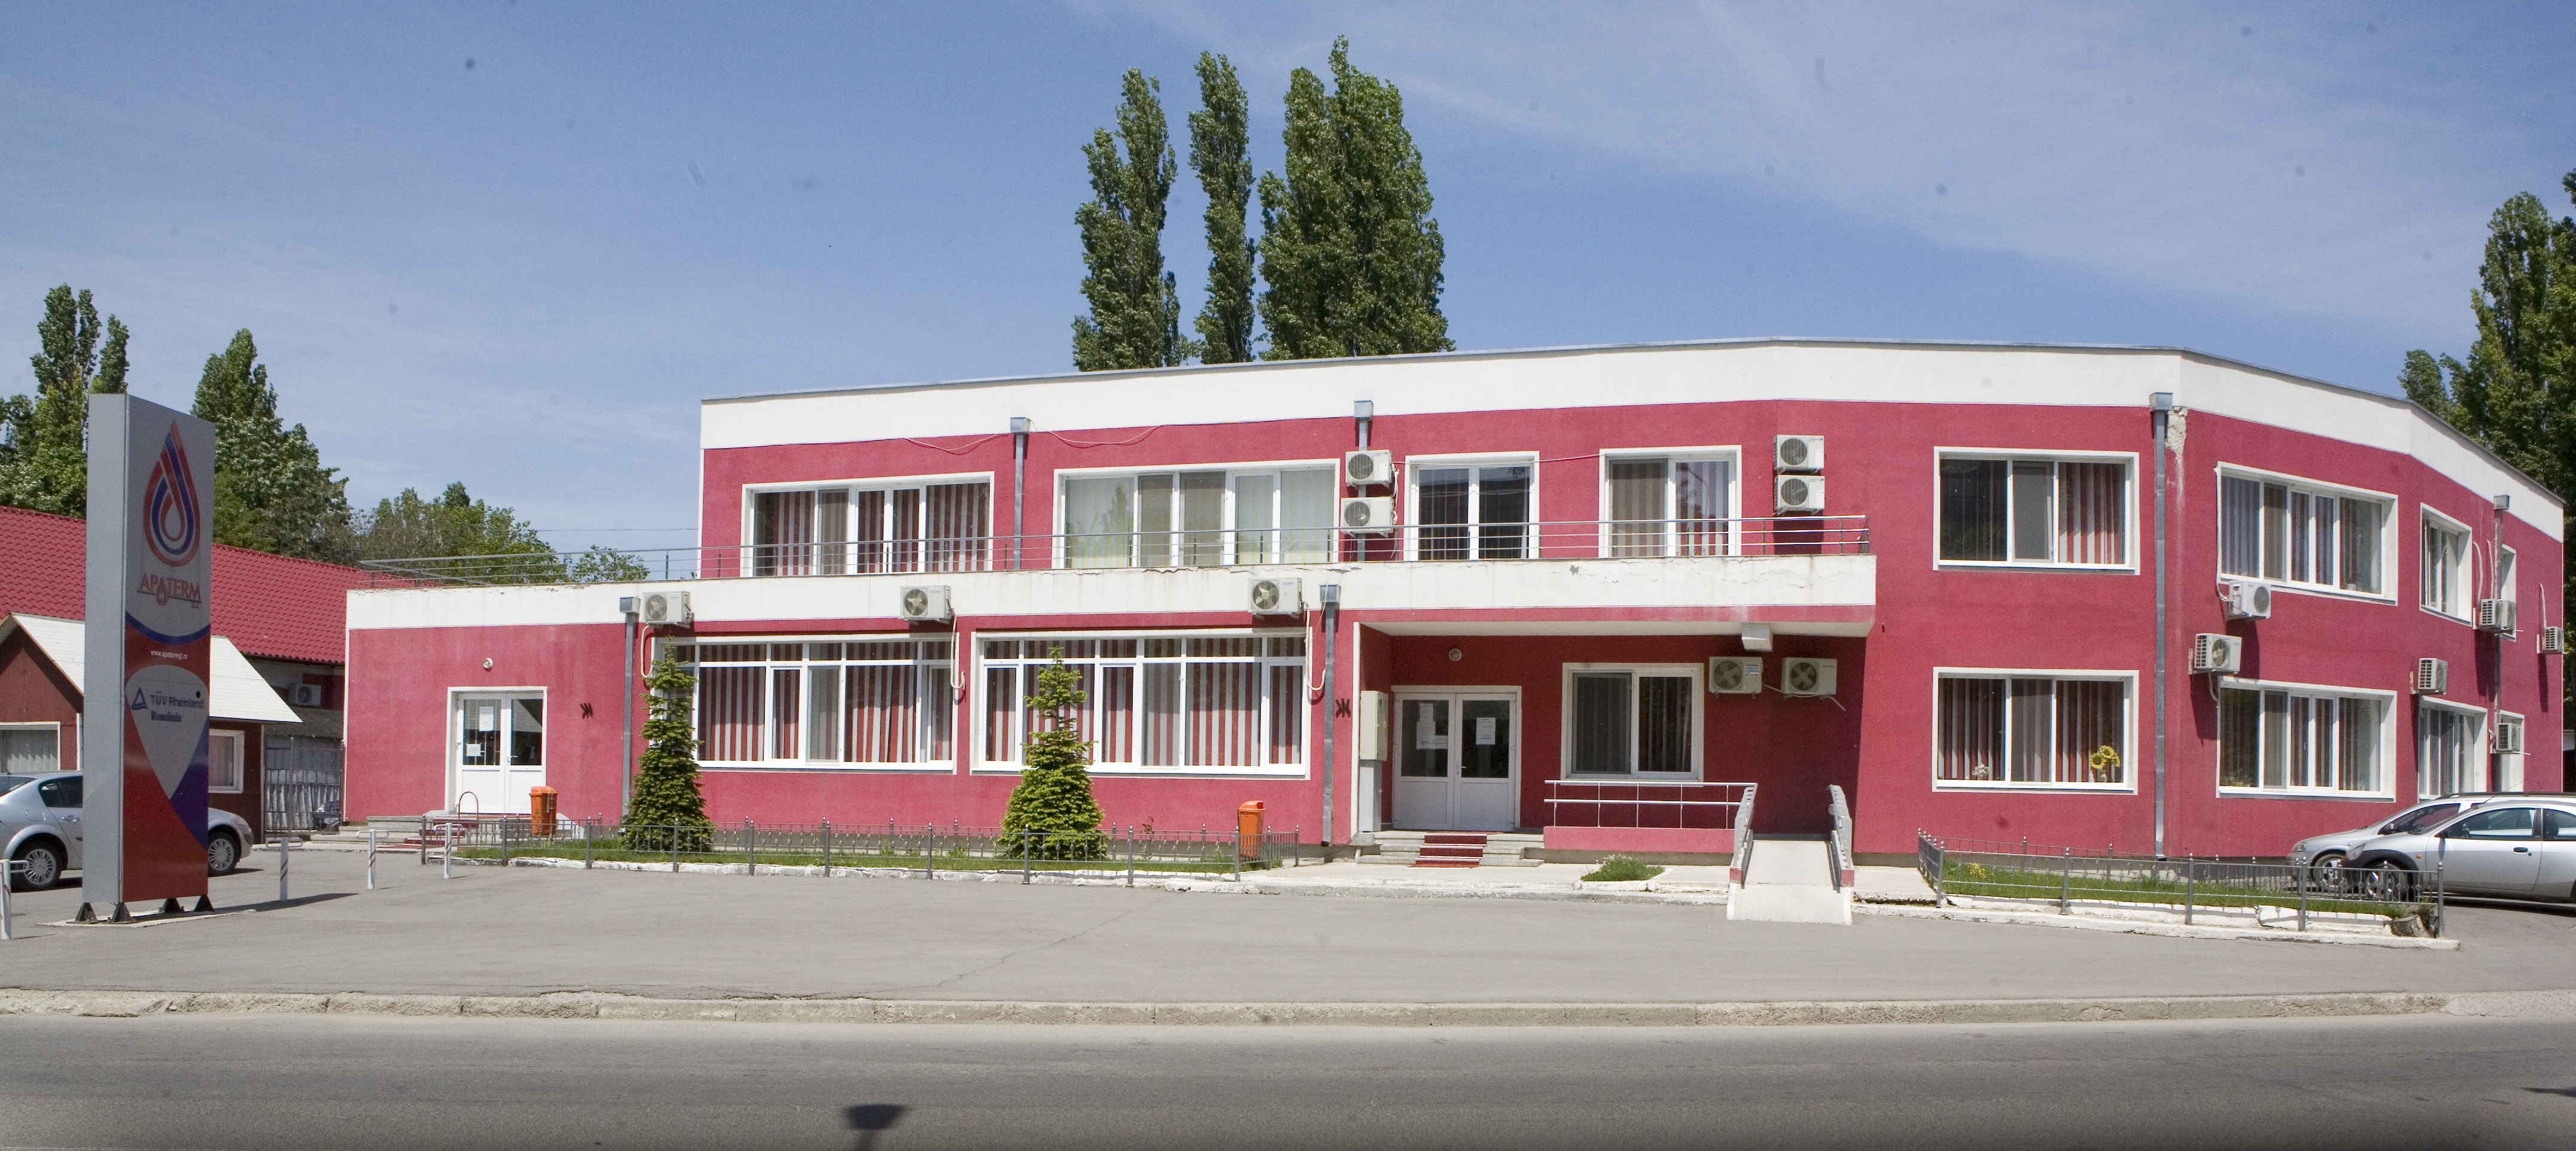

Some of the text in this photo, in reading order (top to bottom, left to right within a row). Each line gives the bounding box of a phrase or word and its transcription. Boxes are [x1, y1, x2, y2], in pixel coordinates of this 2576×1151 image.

[139, 573, 201, 604] APATERM
[151, 650, 188, 660] www.apatermgl.ro
[150, 691, 204, 709] TÜV Rheinland
